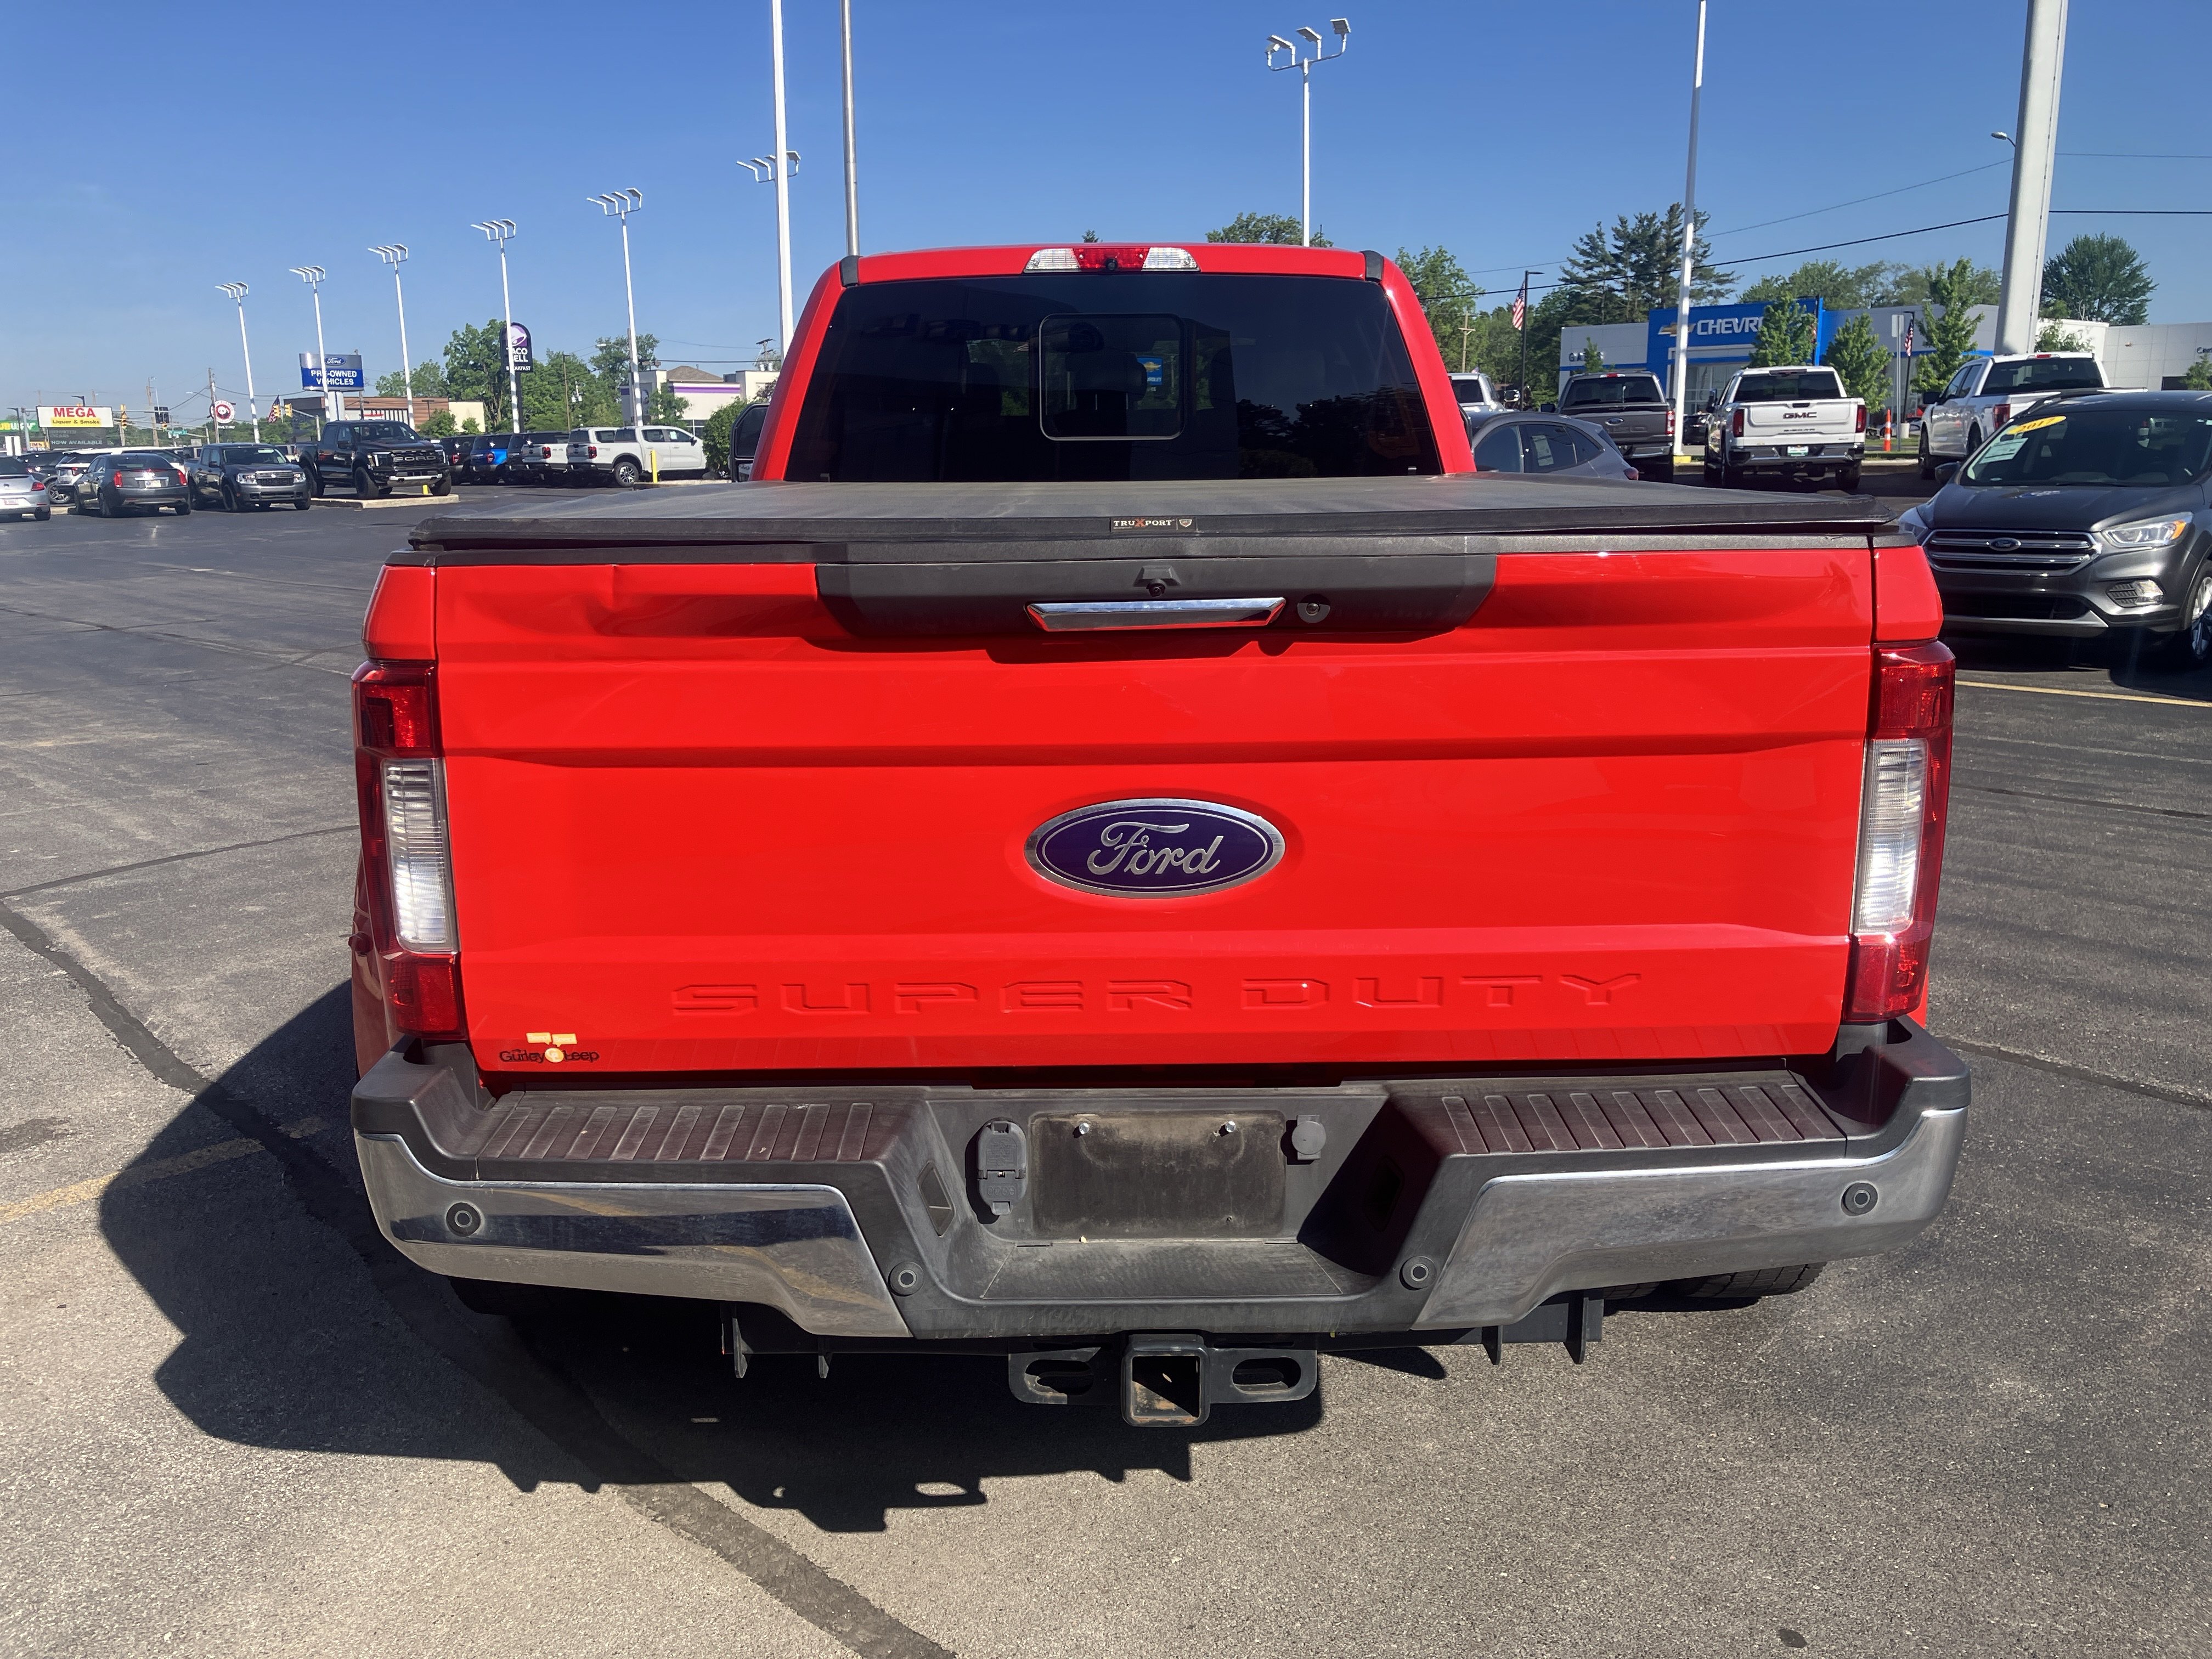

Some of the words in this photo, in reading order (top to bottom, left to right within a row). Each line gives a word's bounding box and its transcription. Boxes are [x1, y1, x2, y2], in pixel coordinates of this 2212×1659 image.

[1697, 316, 1763, 335] CHEVR
[1569, 348, 1604, 362] GAS
[53, 408, 96, 417] MEGA
[1087, 821, 1223, 875] Ford
[672, 980, 1193, 1015] SUPER
[1240, 974, 1641, 1009] DUTY
